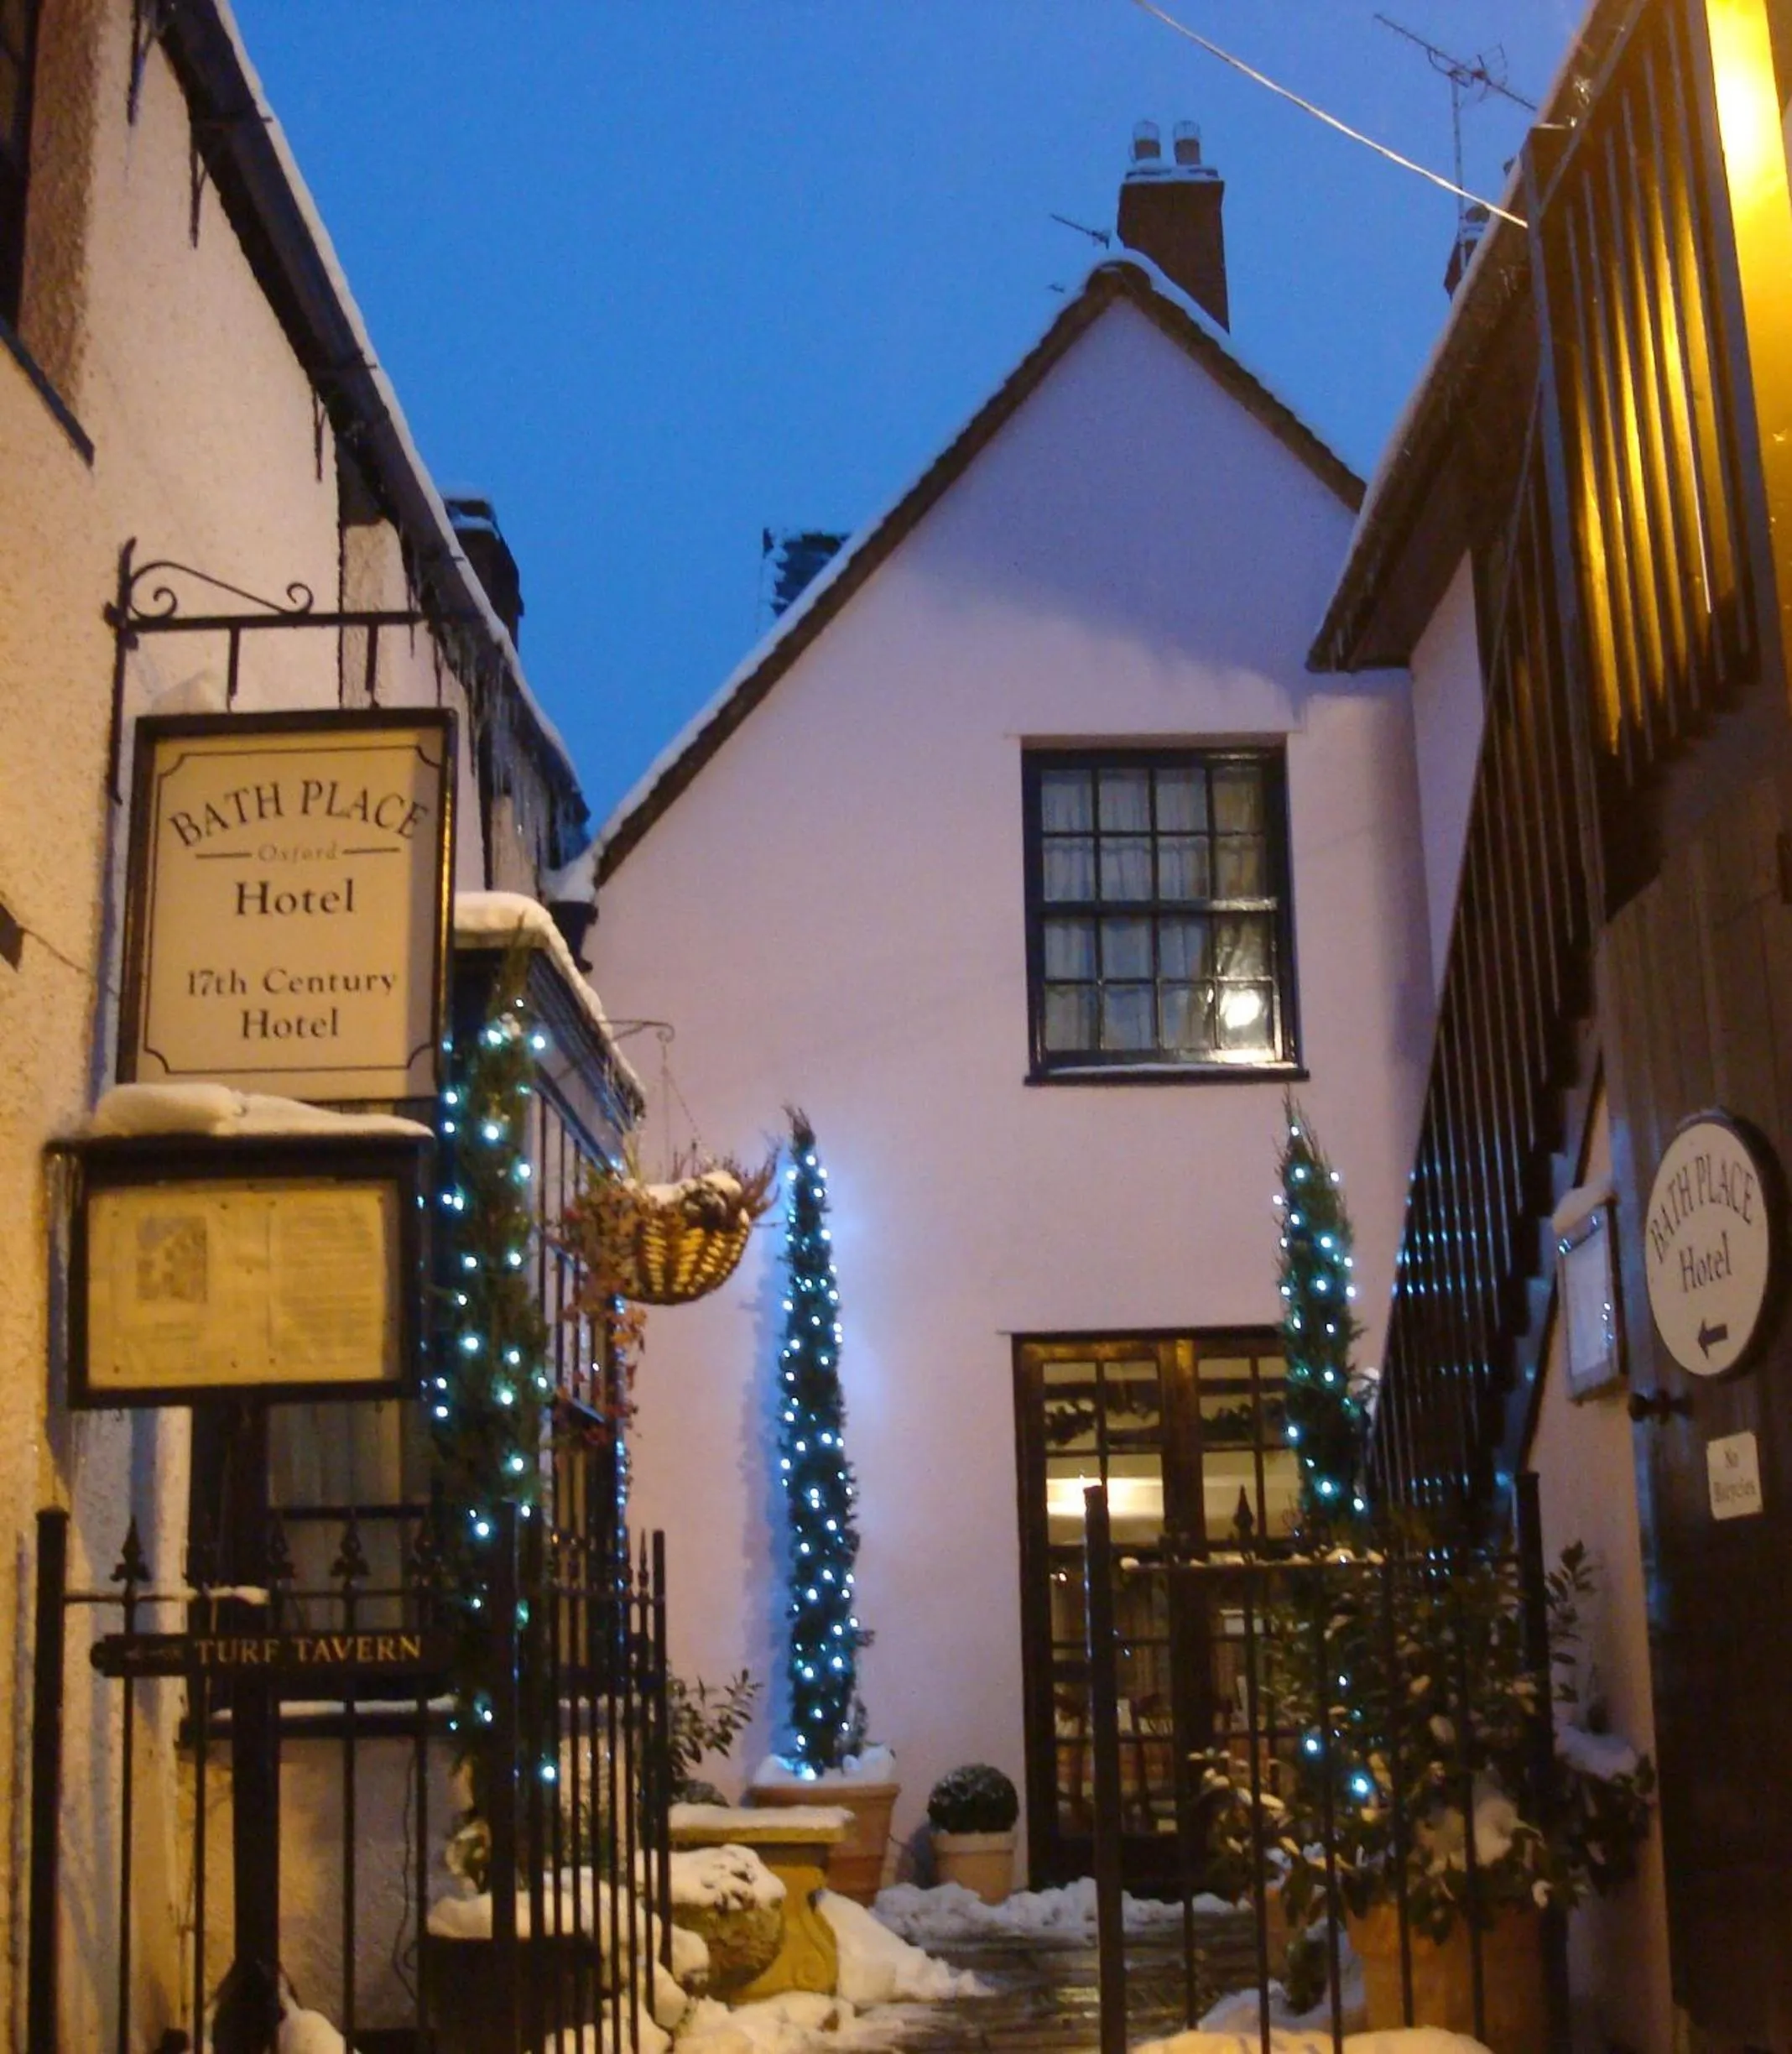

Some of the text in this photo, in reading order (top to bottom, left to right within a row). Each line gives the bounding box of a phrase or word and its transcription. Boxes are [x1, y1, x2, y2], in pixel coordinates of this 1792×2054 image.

[168, 778, 430, 847] BATH PLACE
[258, 842, 338, 864] Oxford
[234, 878, 355, 915] Hotel
[186, 966, 397, 996] 17th Century
[240, 1009, 340, 1040] Hotel
[1649, 1153, 1753, 1265] BATH PLACE
[1679, 1230, 1732, 1293] Hotel
[195, 1635, 421, 1665] TURF TAVERN
